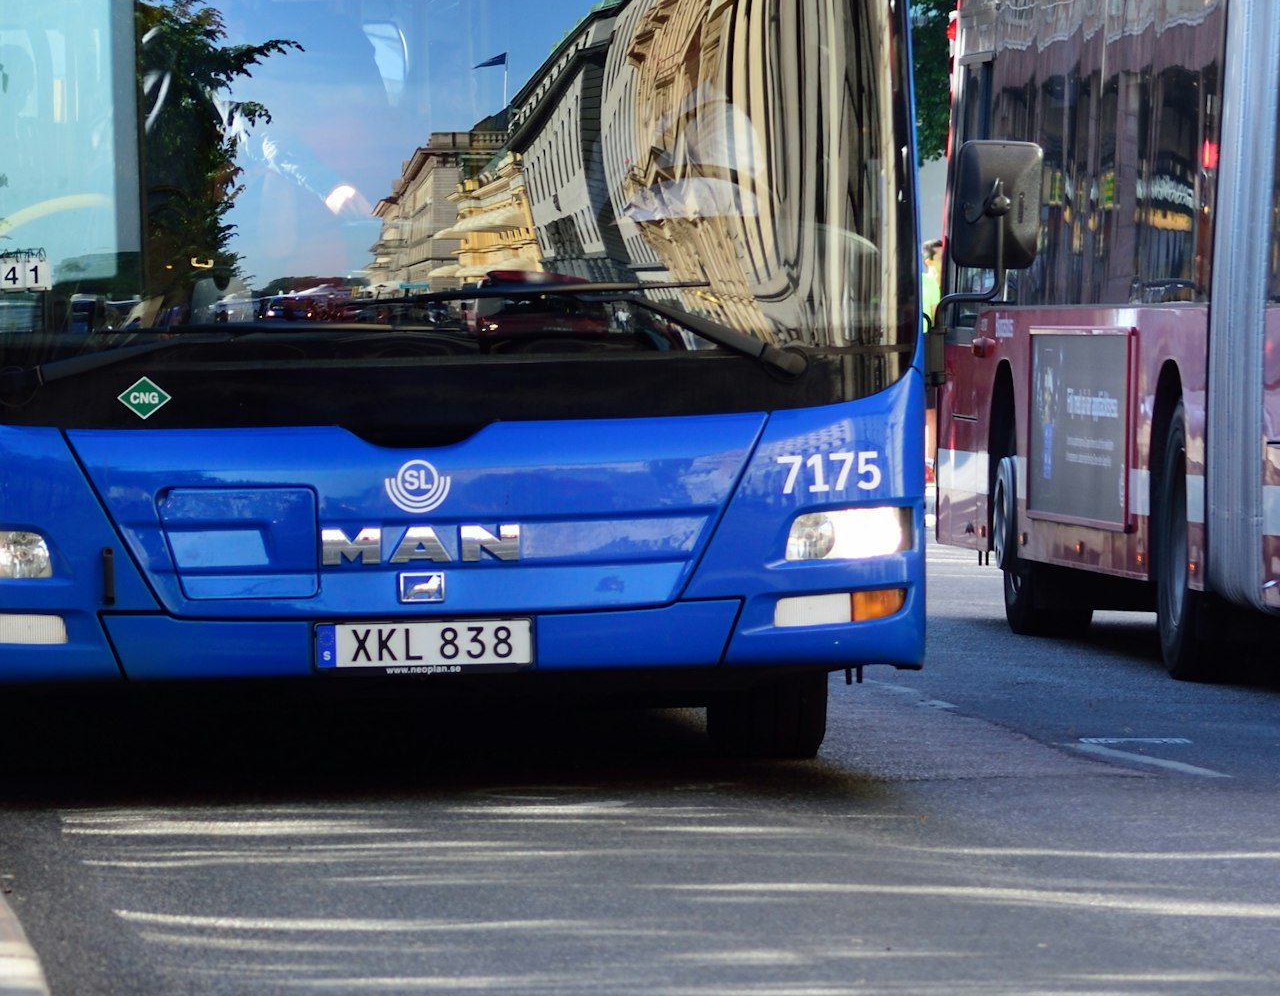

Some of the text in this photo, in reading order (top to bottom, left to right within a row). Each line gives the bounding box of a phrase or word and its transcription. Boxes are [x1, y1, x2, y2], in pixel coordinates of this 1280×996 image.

[129, 391, 159, 404] CNG
[404, 469, 433, 491] SL
[776, 450, 881, 494] 7175
[321, 523, 520, 566] MAN
[323, 626, 513, 662] S XKL 838
[386, 664, 462, 676] www.neoplan.se
